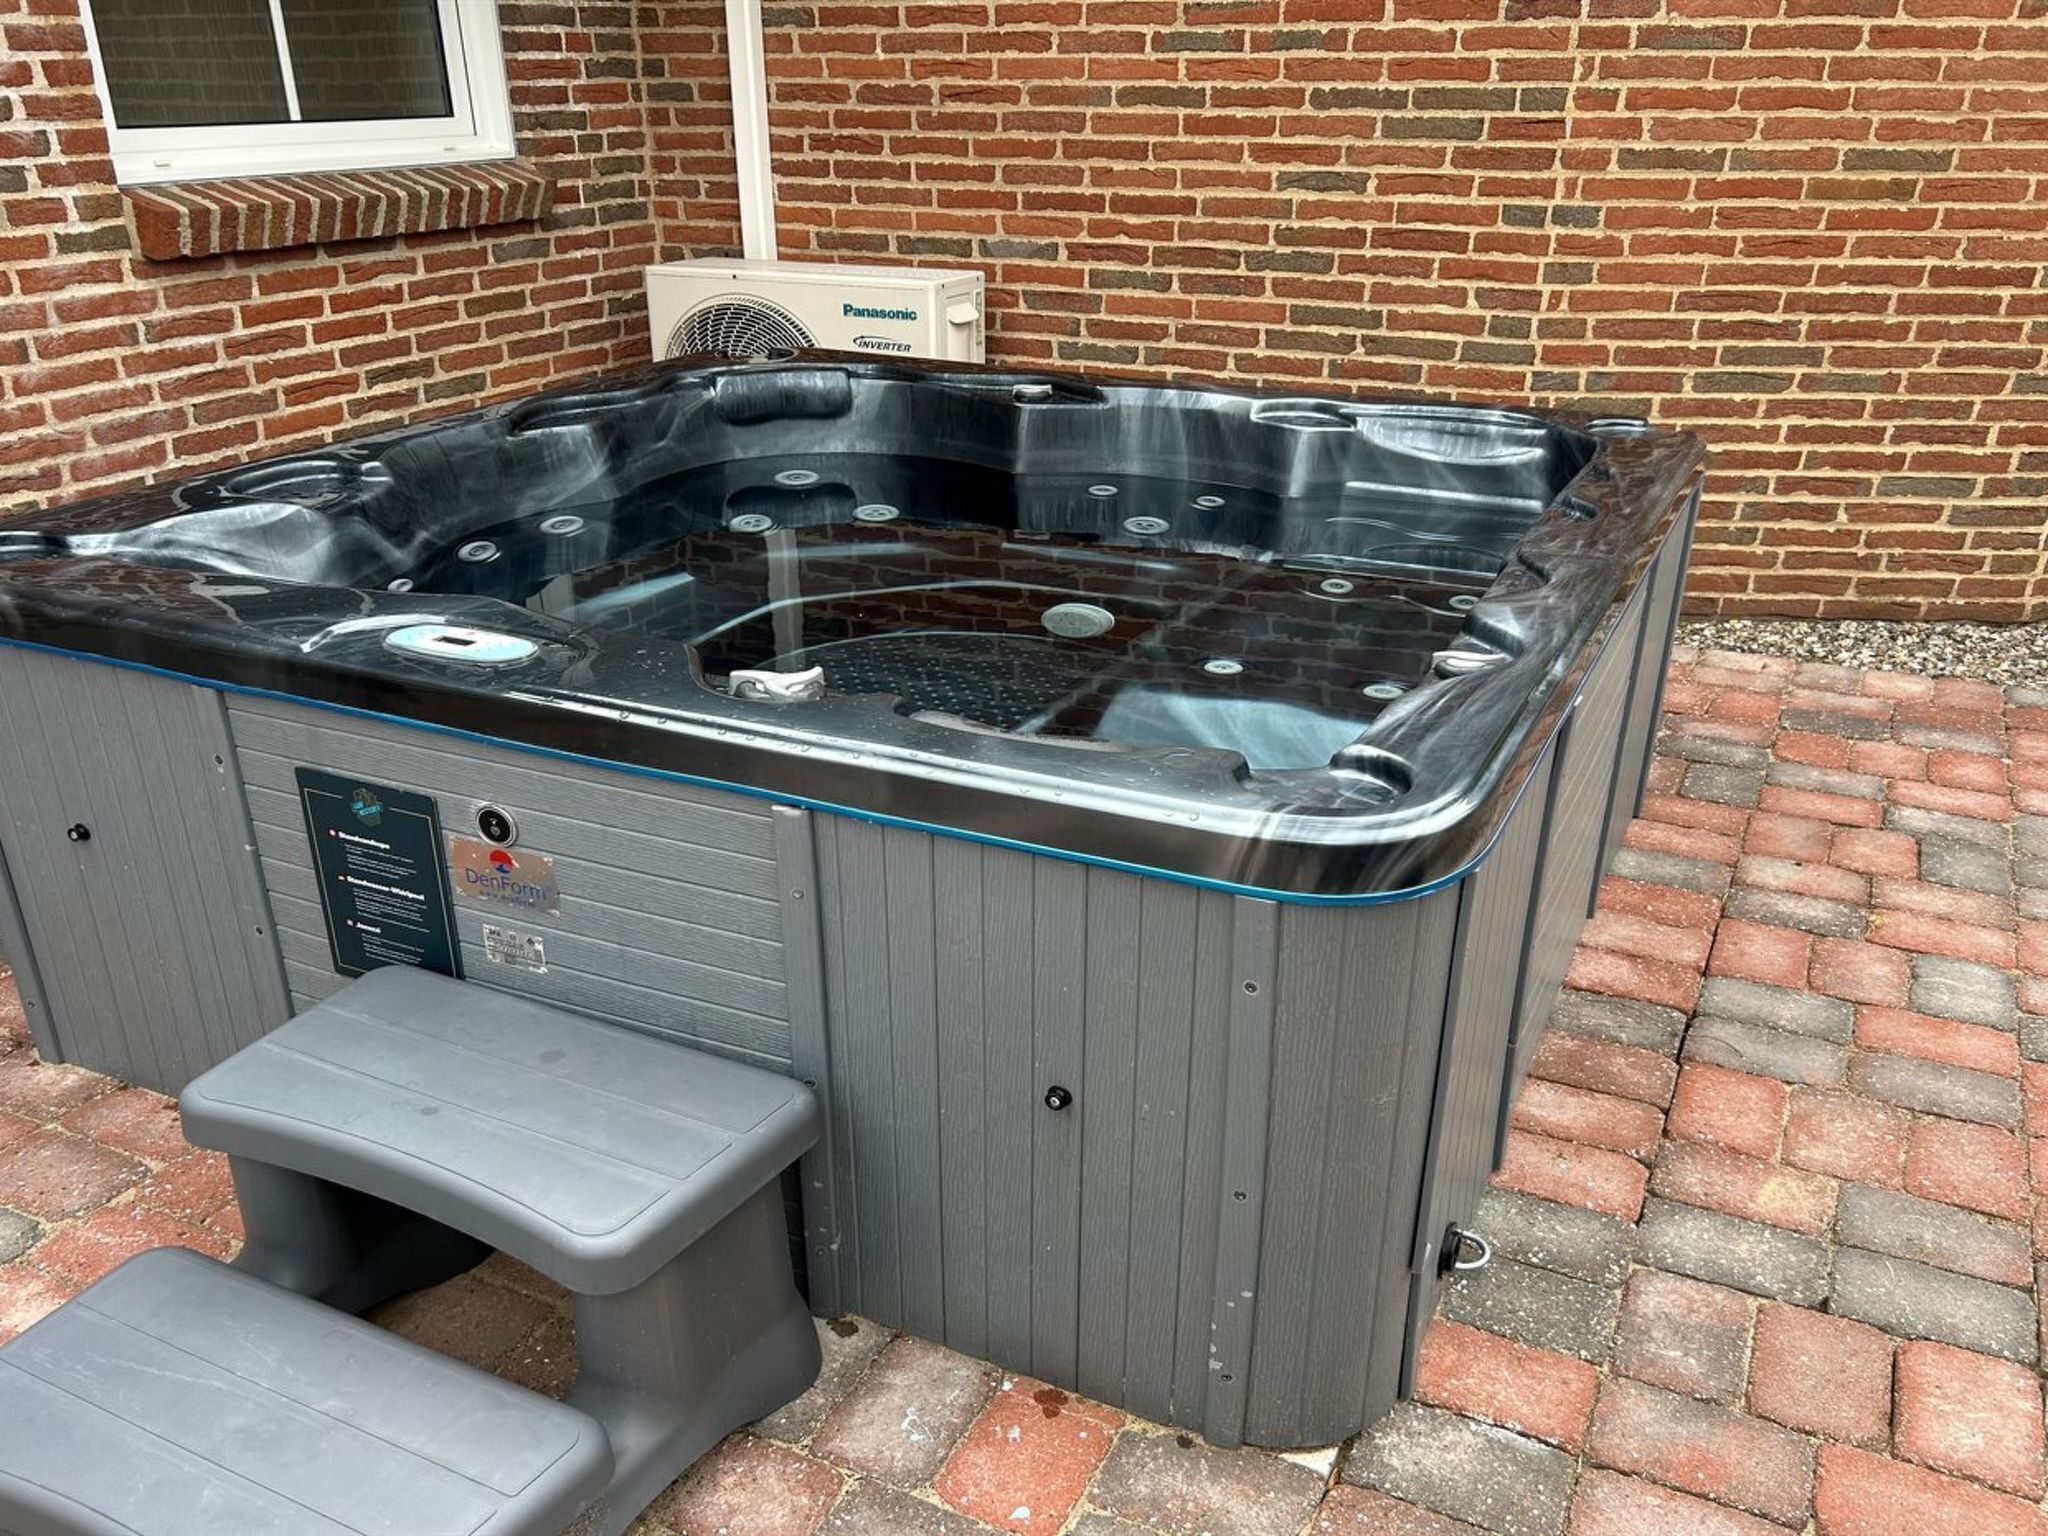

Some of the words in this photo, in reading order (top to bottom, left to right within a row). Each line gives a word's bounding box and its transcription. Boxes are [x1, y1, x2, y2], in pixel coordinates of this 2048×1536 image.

[843, 303, 918, 321] Panasonic
[857, 340, 912, 353] INVERTER
[465, 867, 546, 900] DenForm
